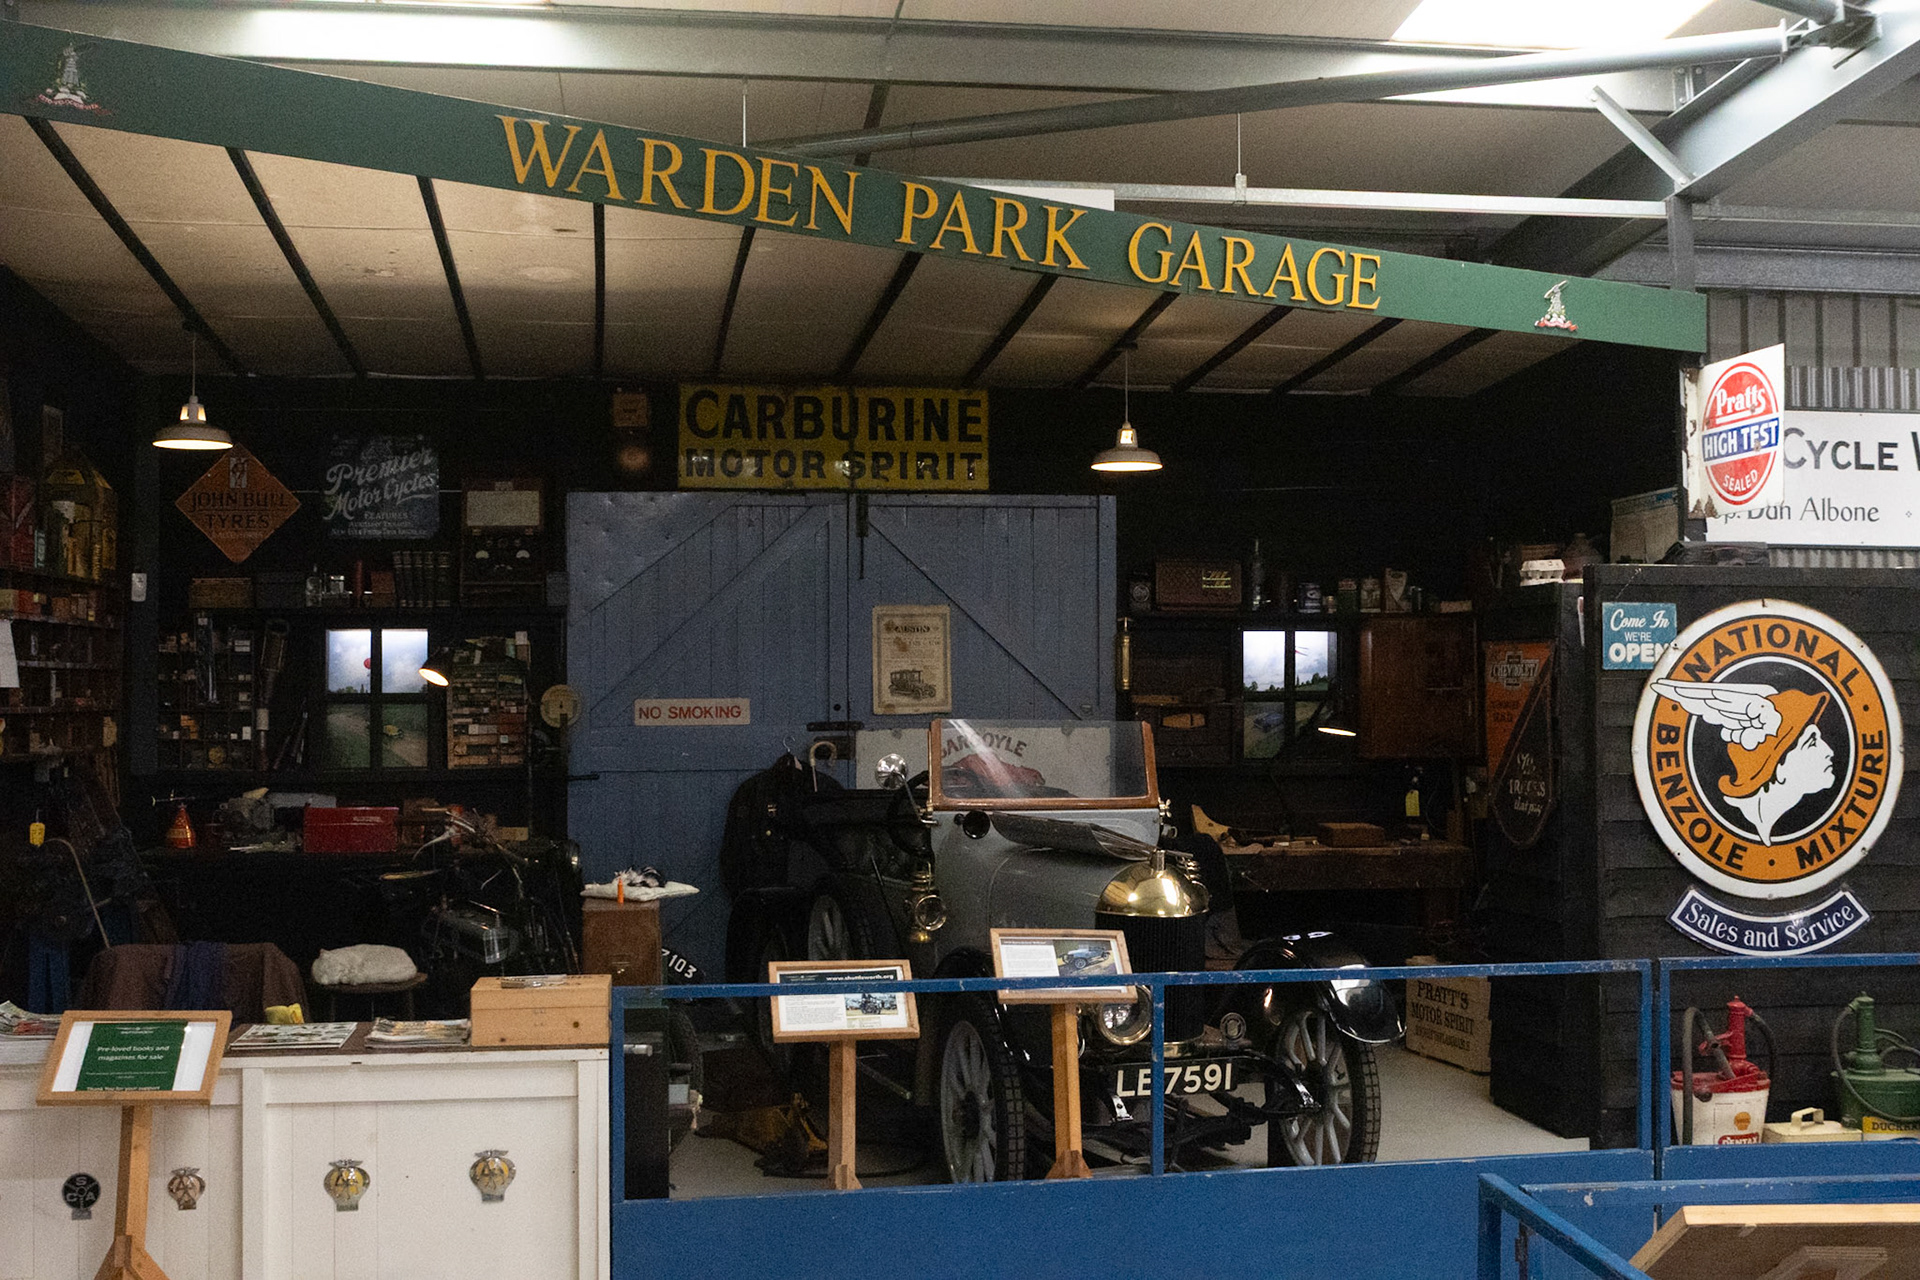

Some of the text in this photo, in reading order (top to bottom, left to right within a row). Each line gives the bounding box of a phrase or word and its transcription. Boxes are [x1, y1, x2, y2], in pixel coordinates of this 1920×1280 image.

[495, 114, 1382, 310] WARDEN PARK GARAGE
[686, 390, 983, 443] CARBURINE
[1714, 384, 1766, 417] Pratts
[1704, 420, 1778, 459] HIGH TEST
[1784, 427, 1899, 471] CYCLE
[324, 446, 434, 495] Premier
[685, 447, 983, 482] MOTOR SPIRIT
[1723, 469, 1758, 492] SEALED
[187, 492, 238, 512] JOHN
[322, 472, 437, 520] Motor Cycles
[1799, 496, 1880, 523] Albone
[204, 514, 270, 529] TYRES
[1610, 608, 1670, 631] Come In
[1624, 631, 1652, 642] WE'RE
[639, 705, 742, 719] NO SMOKING
[941, 732, 1028, 758] AROYLE
[1656, 622, 1885, 872] NATIONAL BENZOLE MIXTURE
[1684, 901, 1854, 948] Sales and Service
[1416, 980, 1470, 1010] PRATT'S
[1411, 1001, 1475, 1035] MOTOR SPIRIT
[1163, 1062, 1233, 1095] 7591
